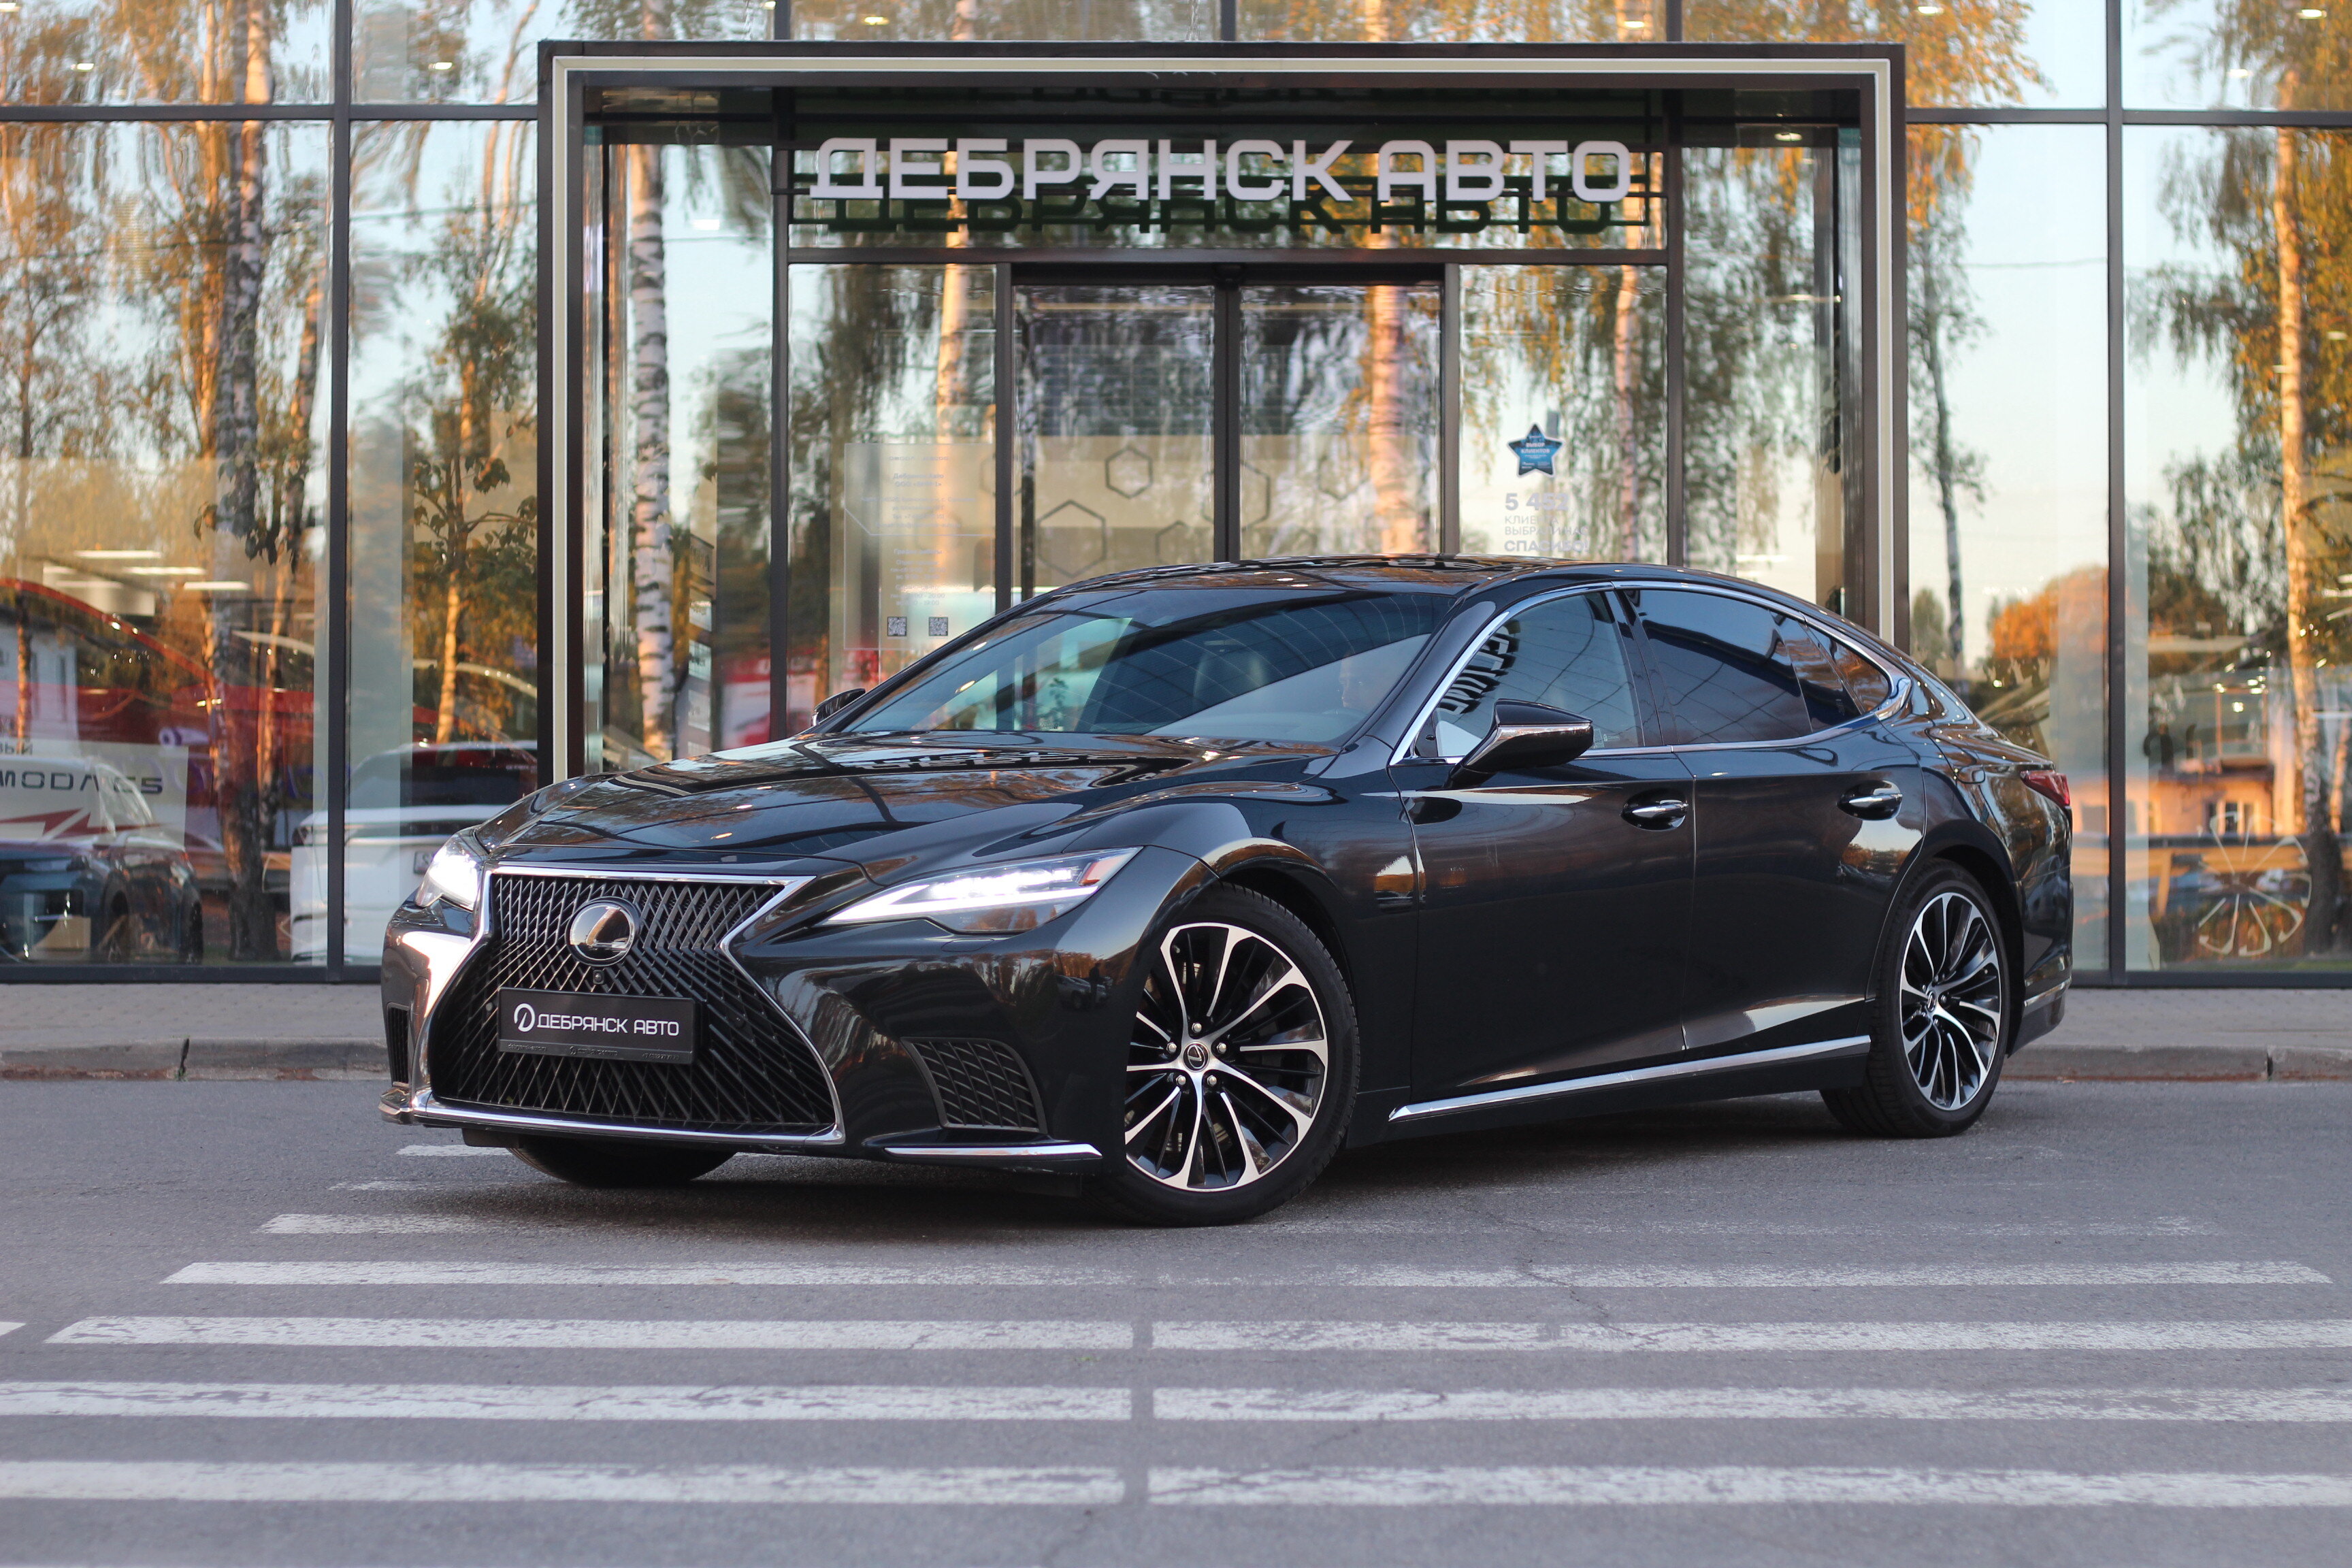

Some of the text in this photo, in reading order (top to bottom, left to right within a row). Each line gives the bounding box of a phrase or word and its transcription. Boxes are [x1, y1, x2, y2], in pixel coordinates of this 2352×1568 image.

[810, 138, 1632, 202] ДЕБРЯНСК АВТО
[1505, 493, 1569, 511] 5 452
[1504, 540, 1589, 552] СПАСИБО!
[537, 1013, 680, 1036] ДЕБРЯНСК АВТО
